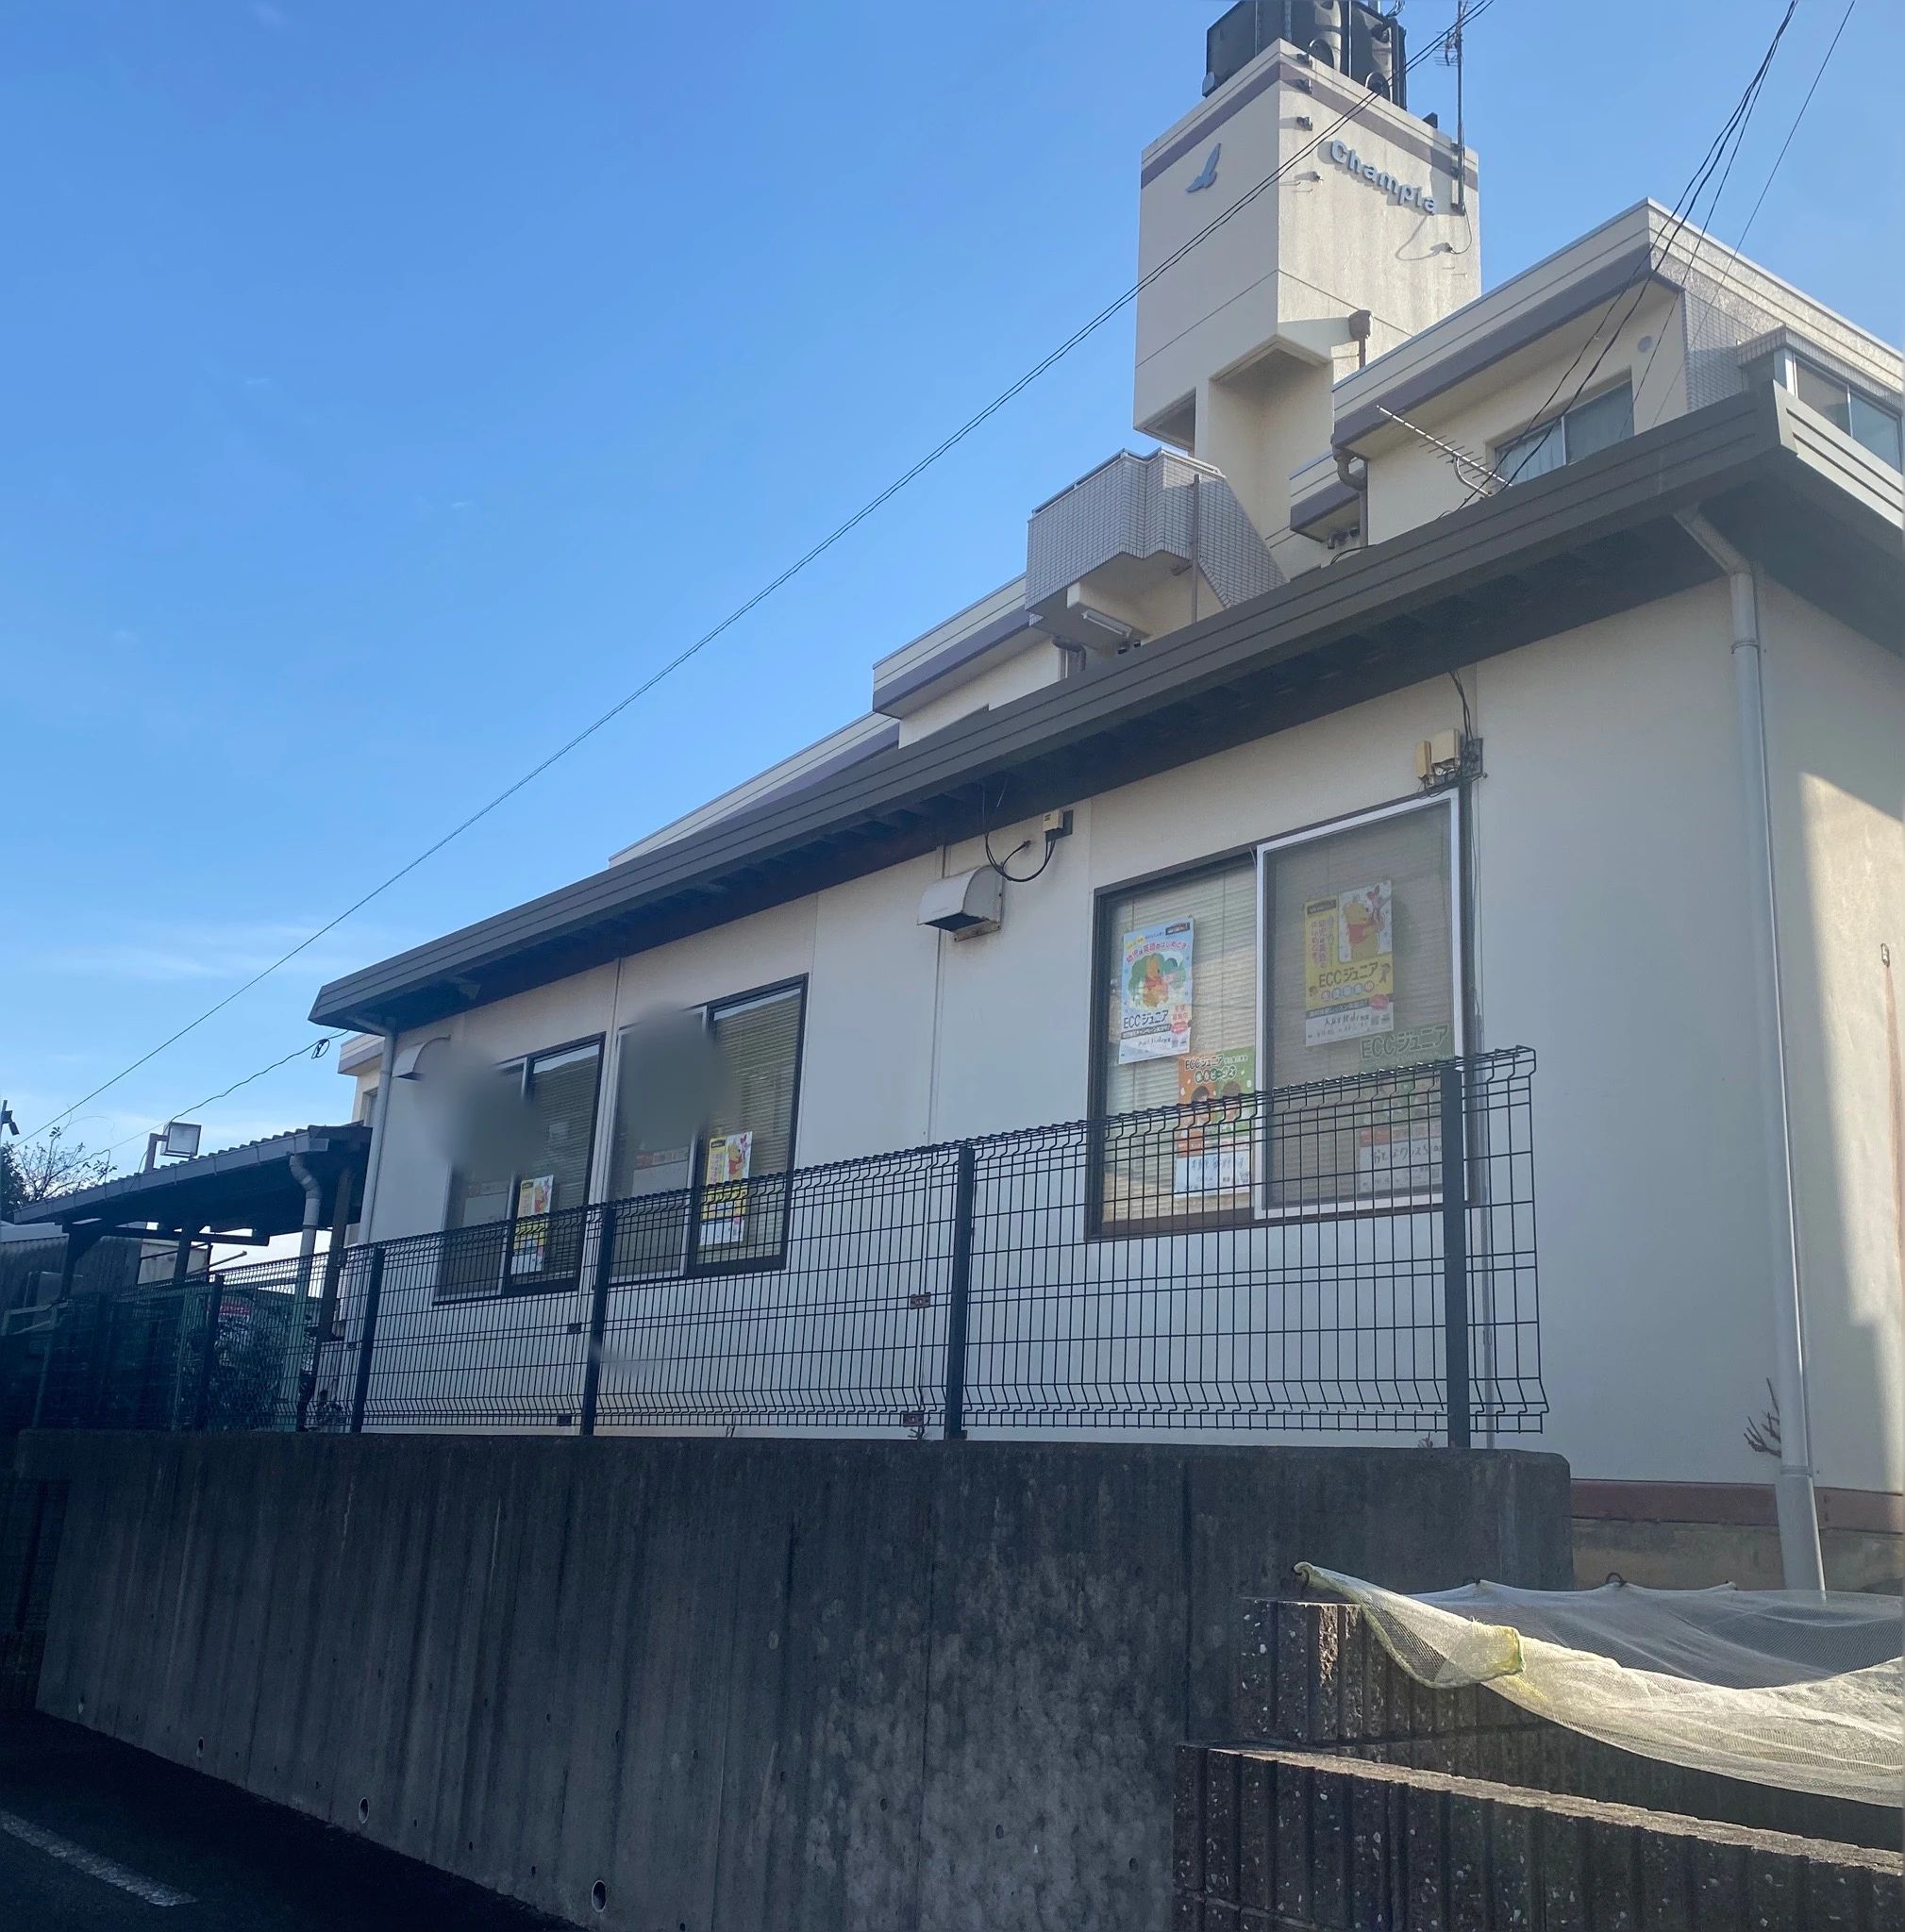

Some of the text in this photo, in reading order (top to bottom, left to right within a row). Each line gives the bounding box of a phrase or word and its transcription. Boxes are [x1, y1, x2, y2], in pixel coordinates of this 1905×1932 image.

[1318, 962, 1379, 988] ECCジュニア
[1123, 1009, 1169, 1029] ECCジュニア
[1361, 1024, 1449, 1059] ECCジュニア
[1185, 1055, 1224, 1070] ECCジュニア
